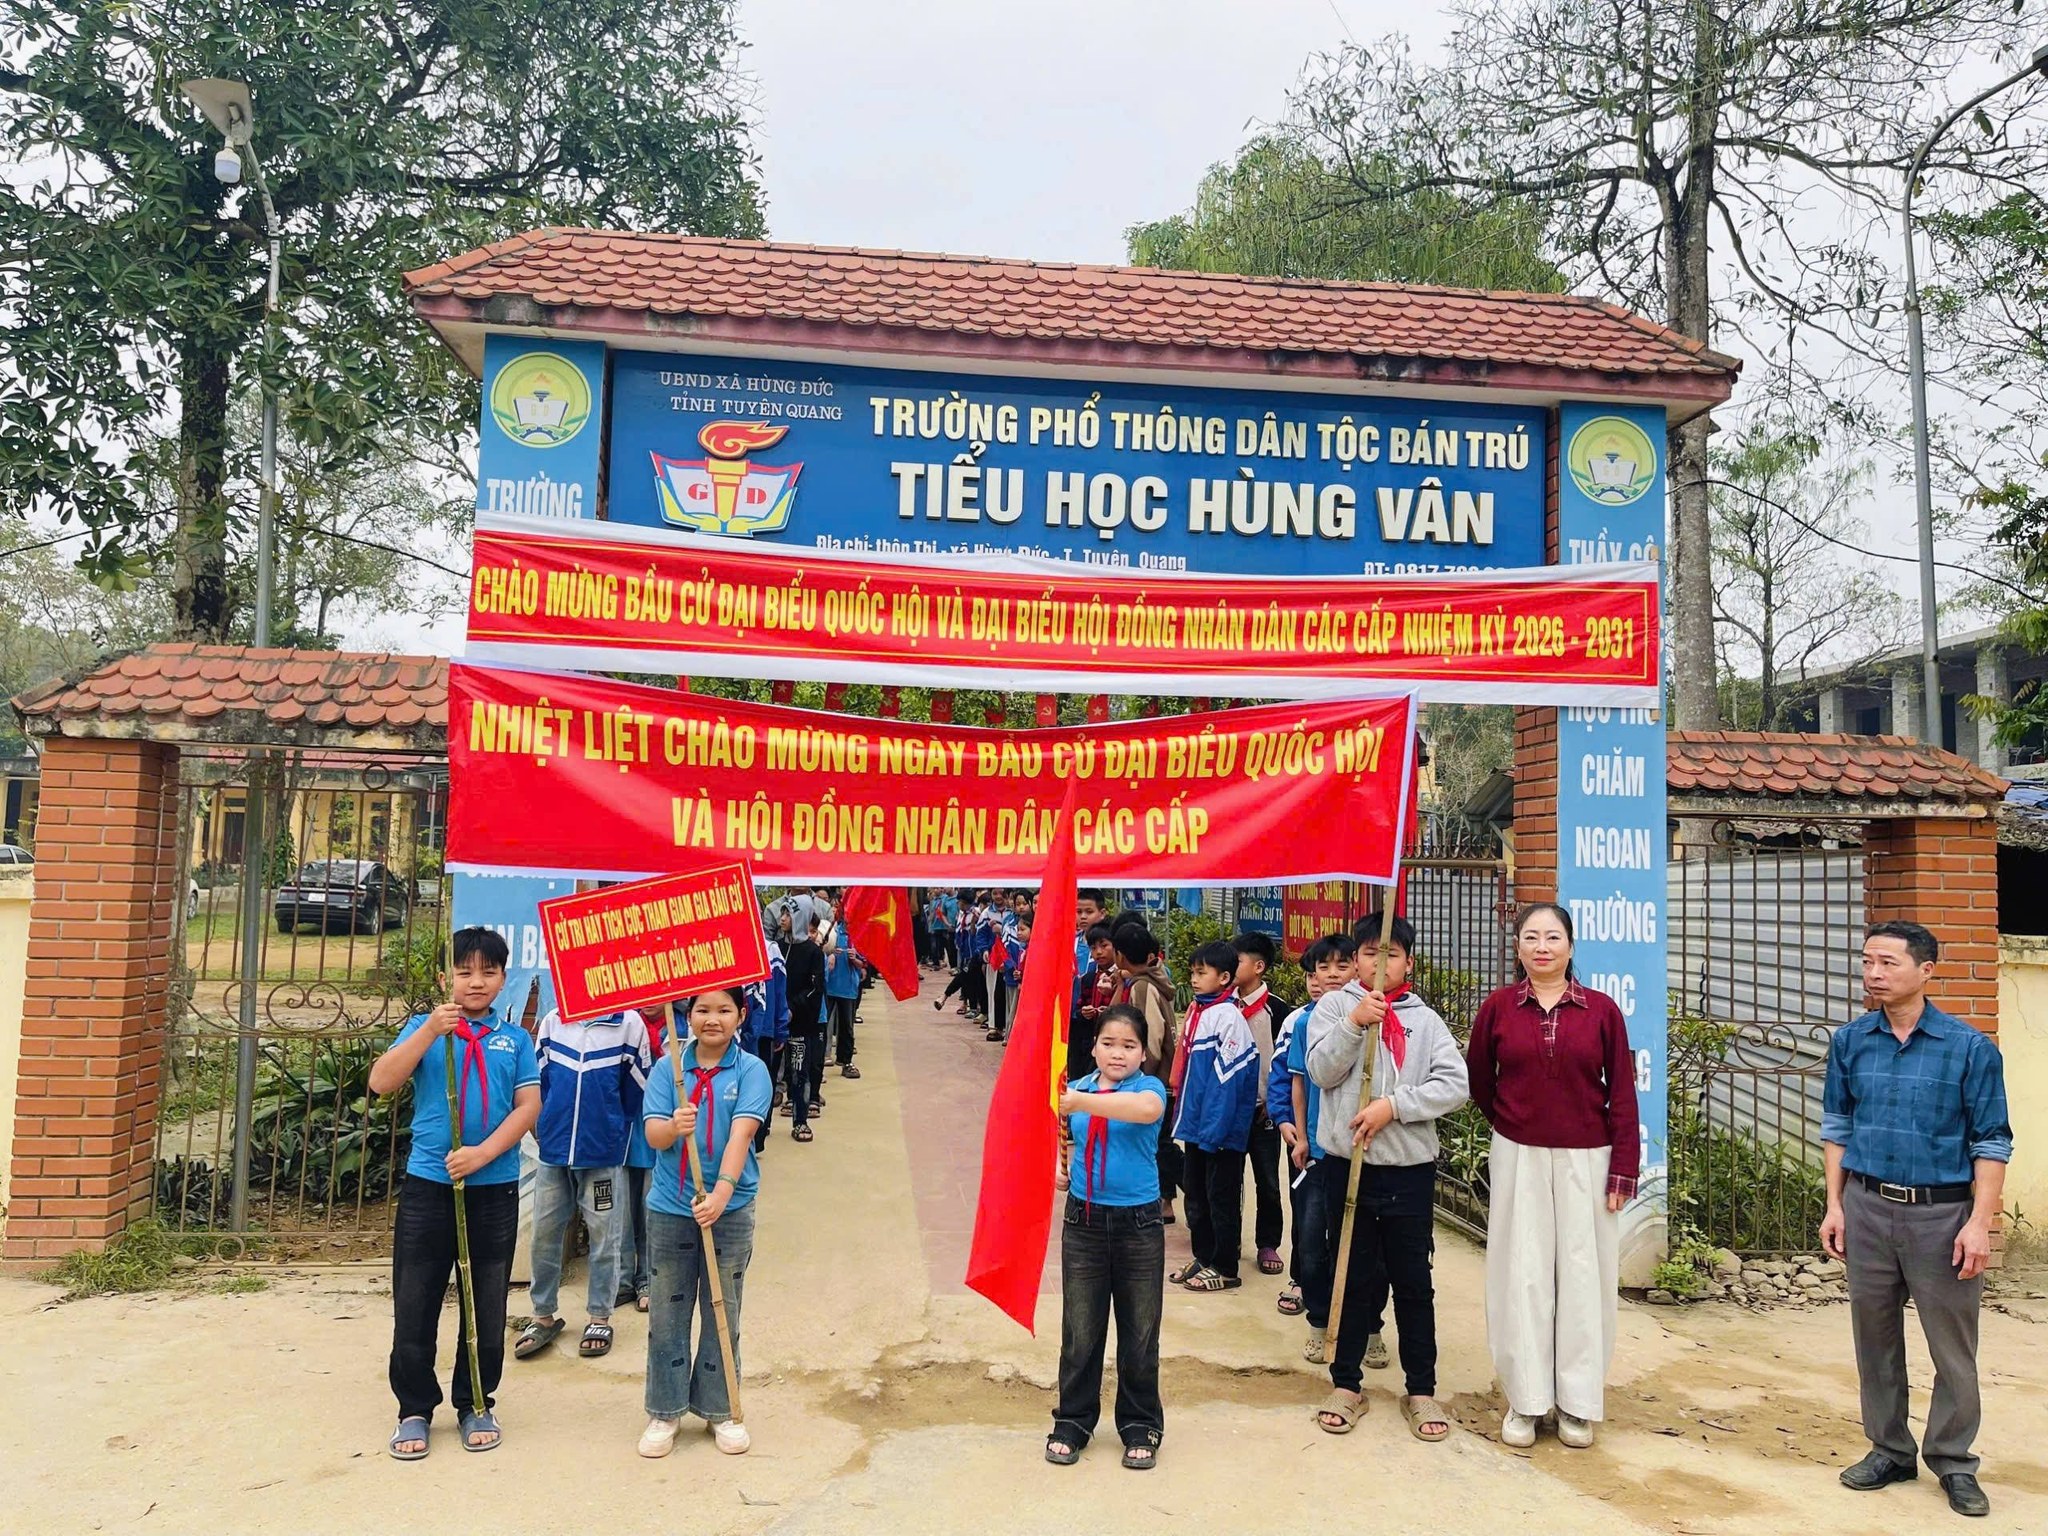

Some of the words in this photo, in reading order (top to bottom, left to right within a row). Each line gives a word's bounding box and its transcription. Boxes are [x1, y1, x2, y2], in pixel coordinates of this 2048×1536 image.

[660, 371, 711, 388] UBND
[715, 373, 742, 390] XÃ
[747, 374, 796, 394] HÙNG
[801, 377, 833, 397] ĐỨC
[671, 391, 716, 413] TỈNH
[722, 398, 782, 417] TUYÊN
[786, 403, 843, 421] QUANG
[870, 391, 1019, 444] TRƯỜNG
[1029, 391, 1101, 449] PHỔ
[1110, 405, 1226, 456] THÔNG
[1235, 411, 1307, 459] DÂN
[1317, 415, 1380, 471] TỘC
[1389, 419, 1458, 467] BÁN
[1465, 424, 1529, 470] TRÚ
[687, 483, 708, 500] G
[890, 440, 1024, 525] TIỂU
[1045, 471, 1169, 541] HỌC
[1188, 466, 1356, 540] HÙNG
[1376, 476, 1495, 545] VÂN
[474, 558, 539, 616] CHÀO
[545, 563, 618, 620] MỪNG
[624, 563, 673, 624] BẦU
[680, 566, 715, 625] CỬ
[717, 584, 758, 637] ĐẠI
[764, 569, 817, 631] BIỂU
[824, 575, 885, 637] QUỐC
[891, 584, 929, 647] HỘI
[937, 586, 965, 640] VÀ
[971, 597, 1009, 651] ĐẠI
[1015, 585, 1067, 645] BIỂU
[1072, 594, 1110, 655] HỘI
[1116, 590, 1177, 649] ĐỒNG
[1183, 599, 1245, 651] NHÂN
[1251, 601, 1297, 652] DÂN
[1302, 601, 1346, 654] CÁC
[1353, 597, 1396, 654] CẤP
[1402, 603, 1473, 664] NHIỆM
[1479, 605, 1507, 657] KỲ
[1513, 615, 1566, 658] 2026
[1570, 636, 1578, 645] -
[1585, 616, 1634, 659] 2031
[469, 696, 573, 767] NHIỆT
[584, 704, 654, 773] LIỆT
[664, 715, 756, 770] CHÀO
[766, 724, 871, 774] MỪNG
[879, 734, 966, 777] NGÀY
[977, 732, 1044, 779] BẦU
[1052, 731, 1096, 779] CỬ
[1104, 737, 1158, 789] ĐẠI
[1166, 723, 1238, 779] BIỂU
[1245, 718, 1325, 782] QUỐC
[1334, 719, 1386, 783] HỘI
[1581, 746, 1645, 797] CHĂM
[671, 787, 714, 848] VÀ
[725, 790, 781, 861] HỘI
[793, 787, 884, 853] ĐỒNG
[895, 797, 986, 855] NHÂN
[996, 799, 1060, 855] DÂN
[1073, 799, 1136, 855] CÁC
[1145, 791, 1208, 855] CẤP
[1575, 826, 1651, 870] NGOAN
[555, 911, 570, 952] CỬ
[568, 918, 586, 948] TRI
[583, 909, 604, 945] HÃY
[602, 905, 626, 941] TÍCH
[623, 903, 645, 942] CỰC
[641, 899, 671, 932] THAM
[668, 893, 695, 926] GIAM
[693, 890, 712, 921] GIA
[728, 873, 743, 913] CỬ
[1569, 890, 1657, 944] TRƯỜNG
[584, 955, 617, 1000] QUYỀN
[613, 955, 630, 990] VÀ
[627, 950, 658, 988] NGHĨA
[655, 951, 671, 987] VỤ
[668, 938, 691, 979] CỦA
[688, 938, 716, 975] CÔNG
[712, 931, 736, 970] DÂN
